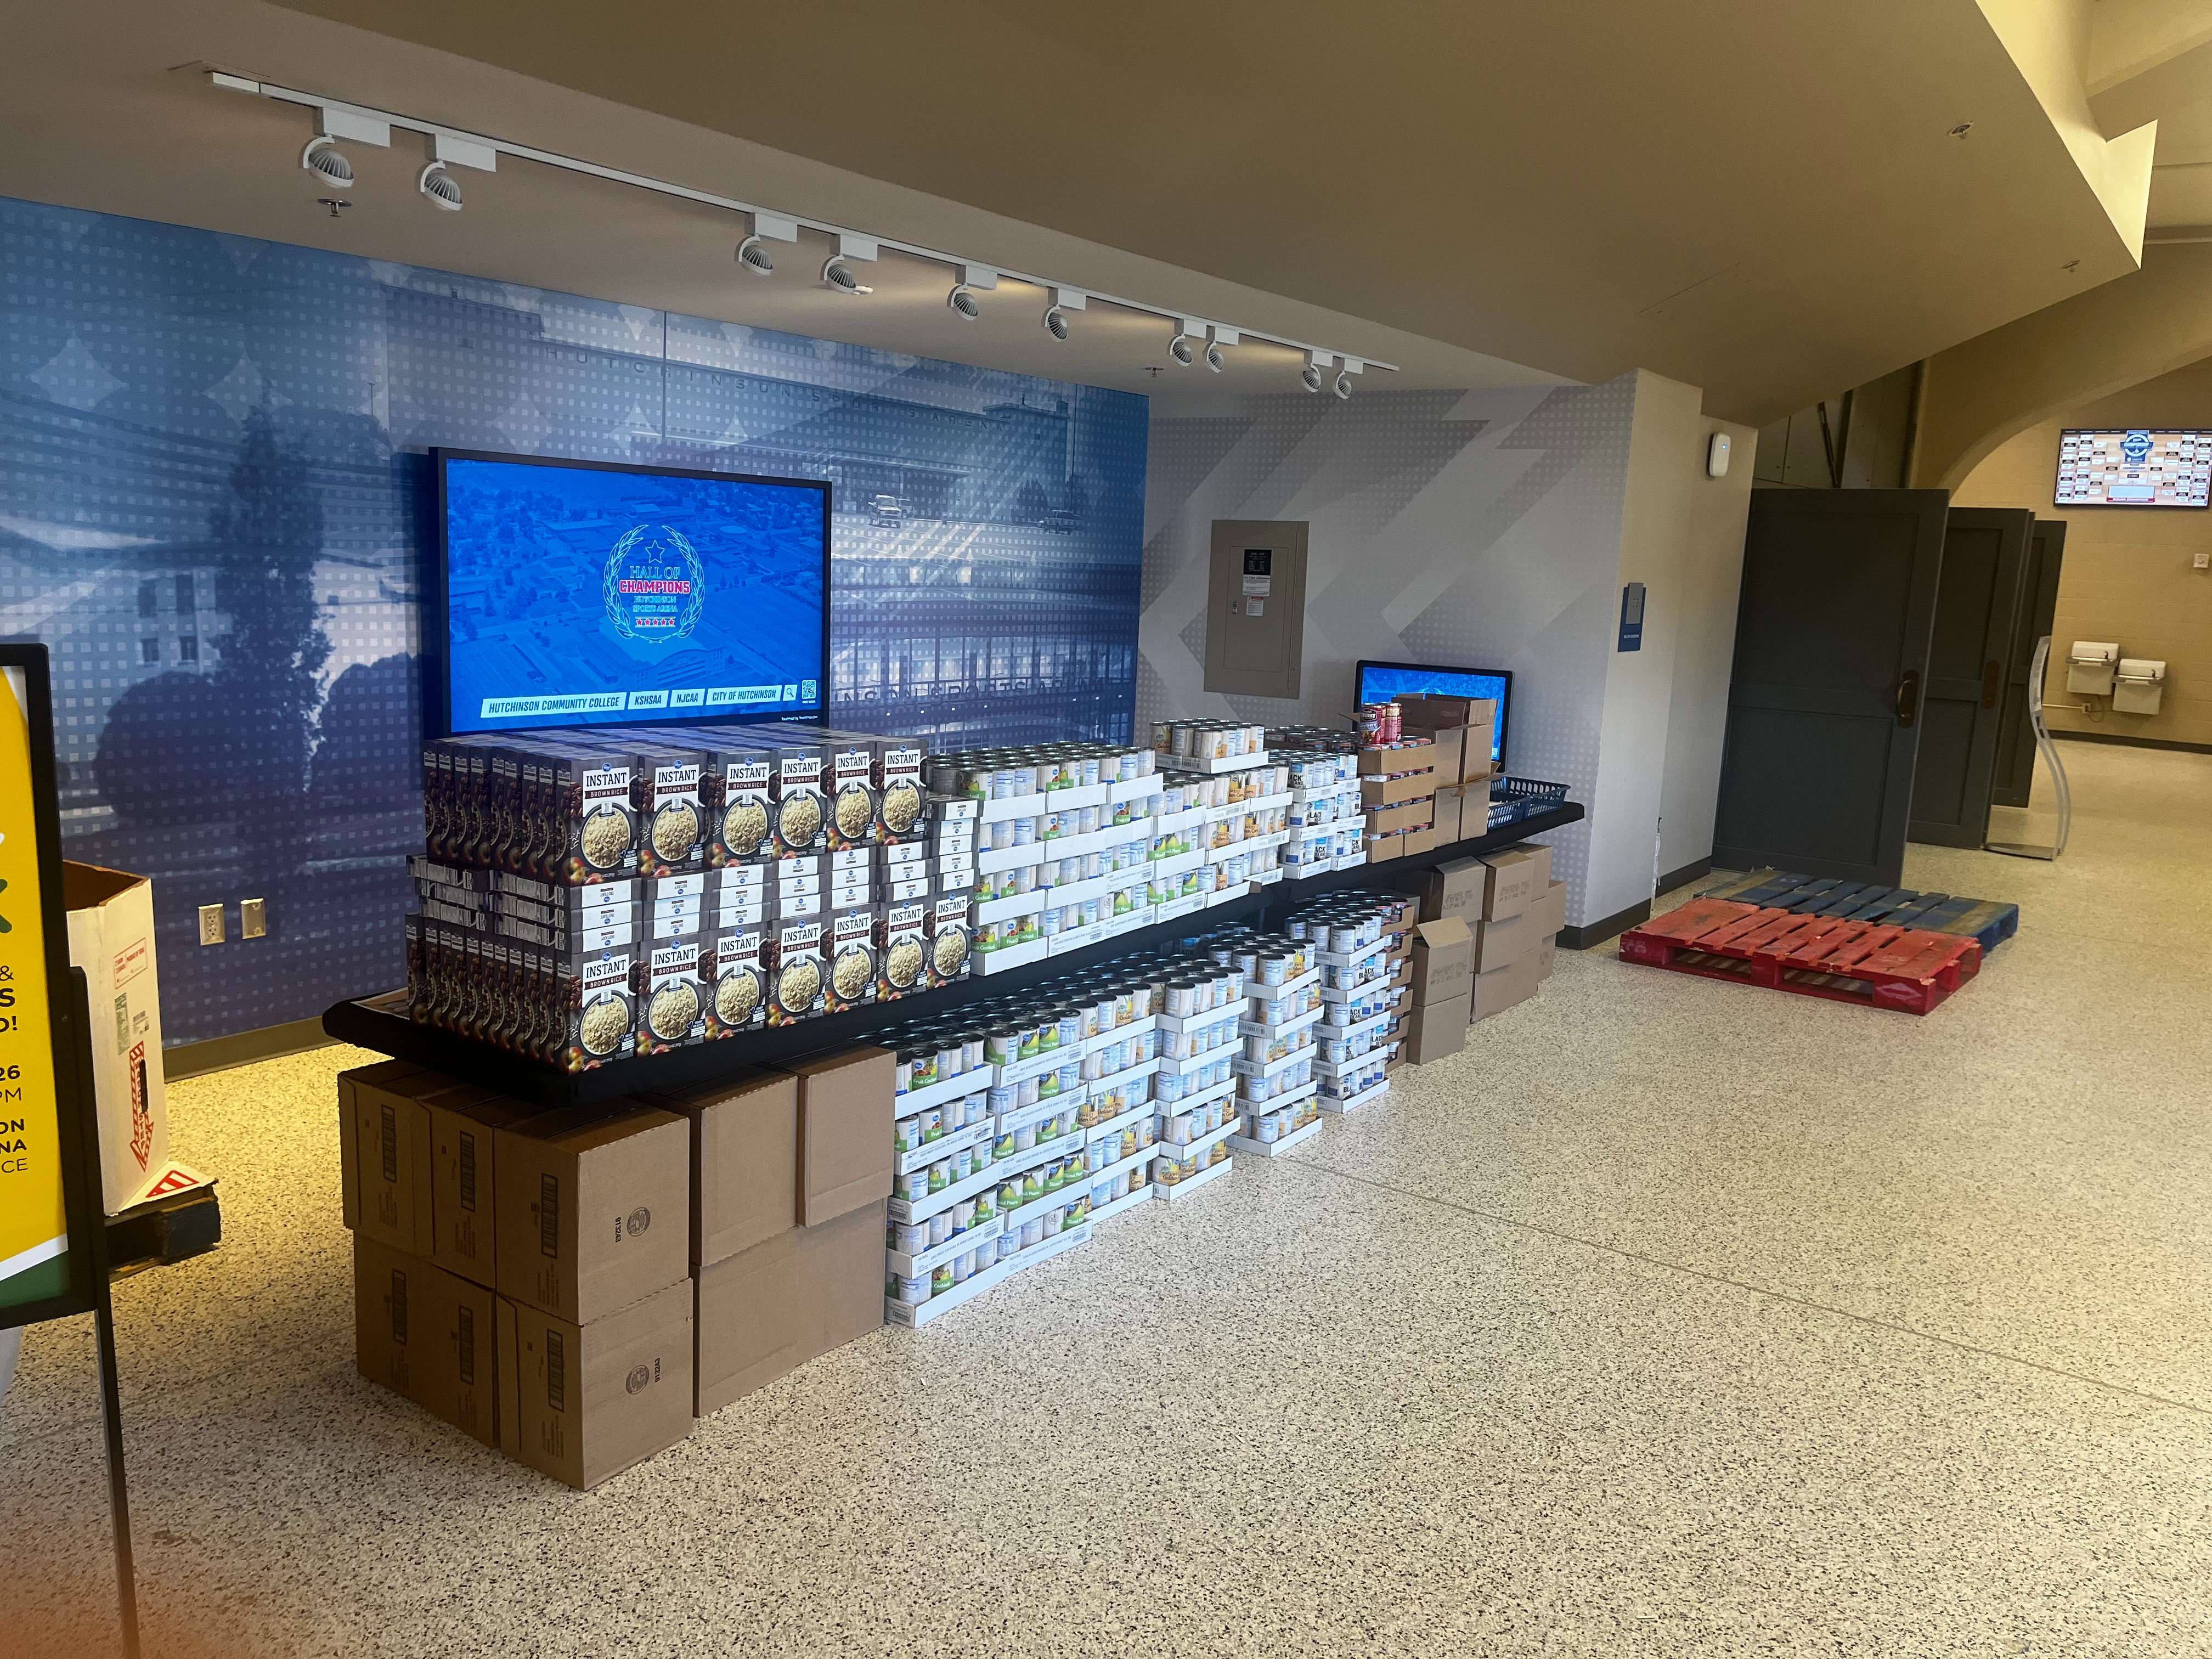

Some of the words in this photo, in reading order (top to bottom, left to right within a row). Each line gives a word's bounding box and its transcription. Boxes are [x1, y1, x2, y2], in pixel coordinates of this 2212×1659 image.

[630, 566, 662, 579] HALL
[664, 566, 681, 579] OF
[619, 579, 691, 594] CHAMPIONS
[635, 695, 662, 706] KSHSAA
[676, 693, 698, 703] NJCAA
[712, 691, 727, 701] CITY
[729, 691, 737, 700] OF
[738, 689, 776, 699] HUTCHINSON
[489, 701, 539, 713] HUTCHINSON
[541, 698, 588, 710] COMMUNITY
[589, 697, 619, 708] COLLEGE
[838, 756, 867, 768] INSTANT
[887, 754, 918, 765] INSTANT
[730, 767, 767, 779] INSTANT
[784, 762, 819, 774] INSTANT
[586, 772, 627, 787] INSTANT
[658, 770, 696, 783] INSTANT
[938, 900, 966, 913] INSTANT
[891, 909, 921, 923] INSTANT
[837, 917, 869, 932] INSTANT
[784, 927, 819, 943] INSTANT
[720, 936, 757, 952] INSTANT
[654, 949, 696, 965] INSTANT
[586, 960, 627, 978] INSTANT
[590, 979, 610, 988] BROWN
